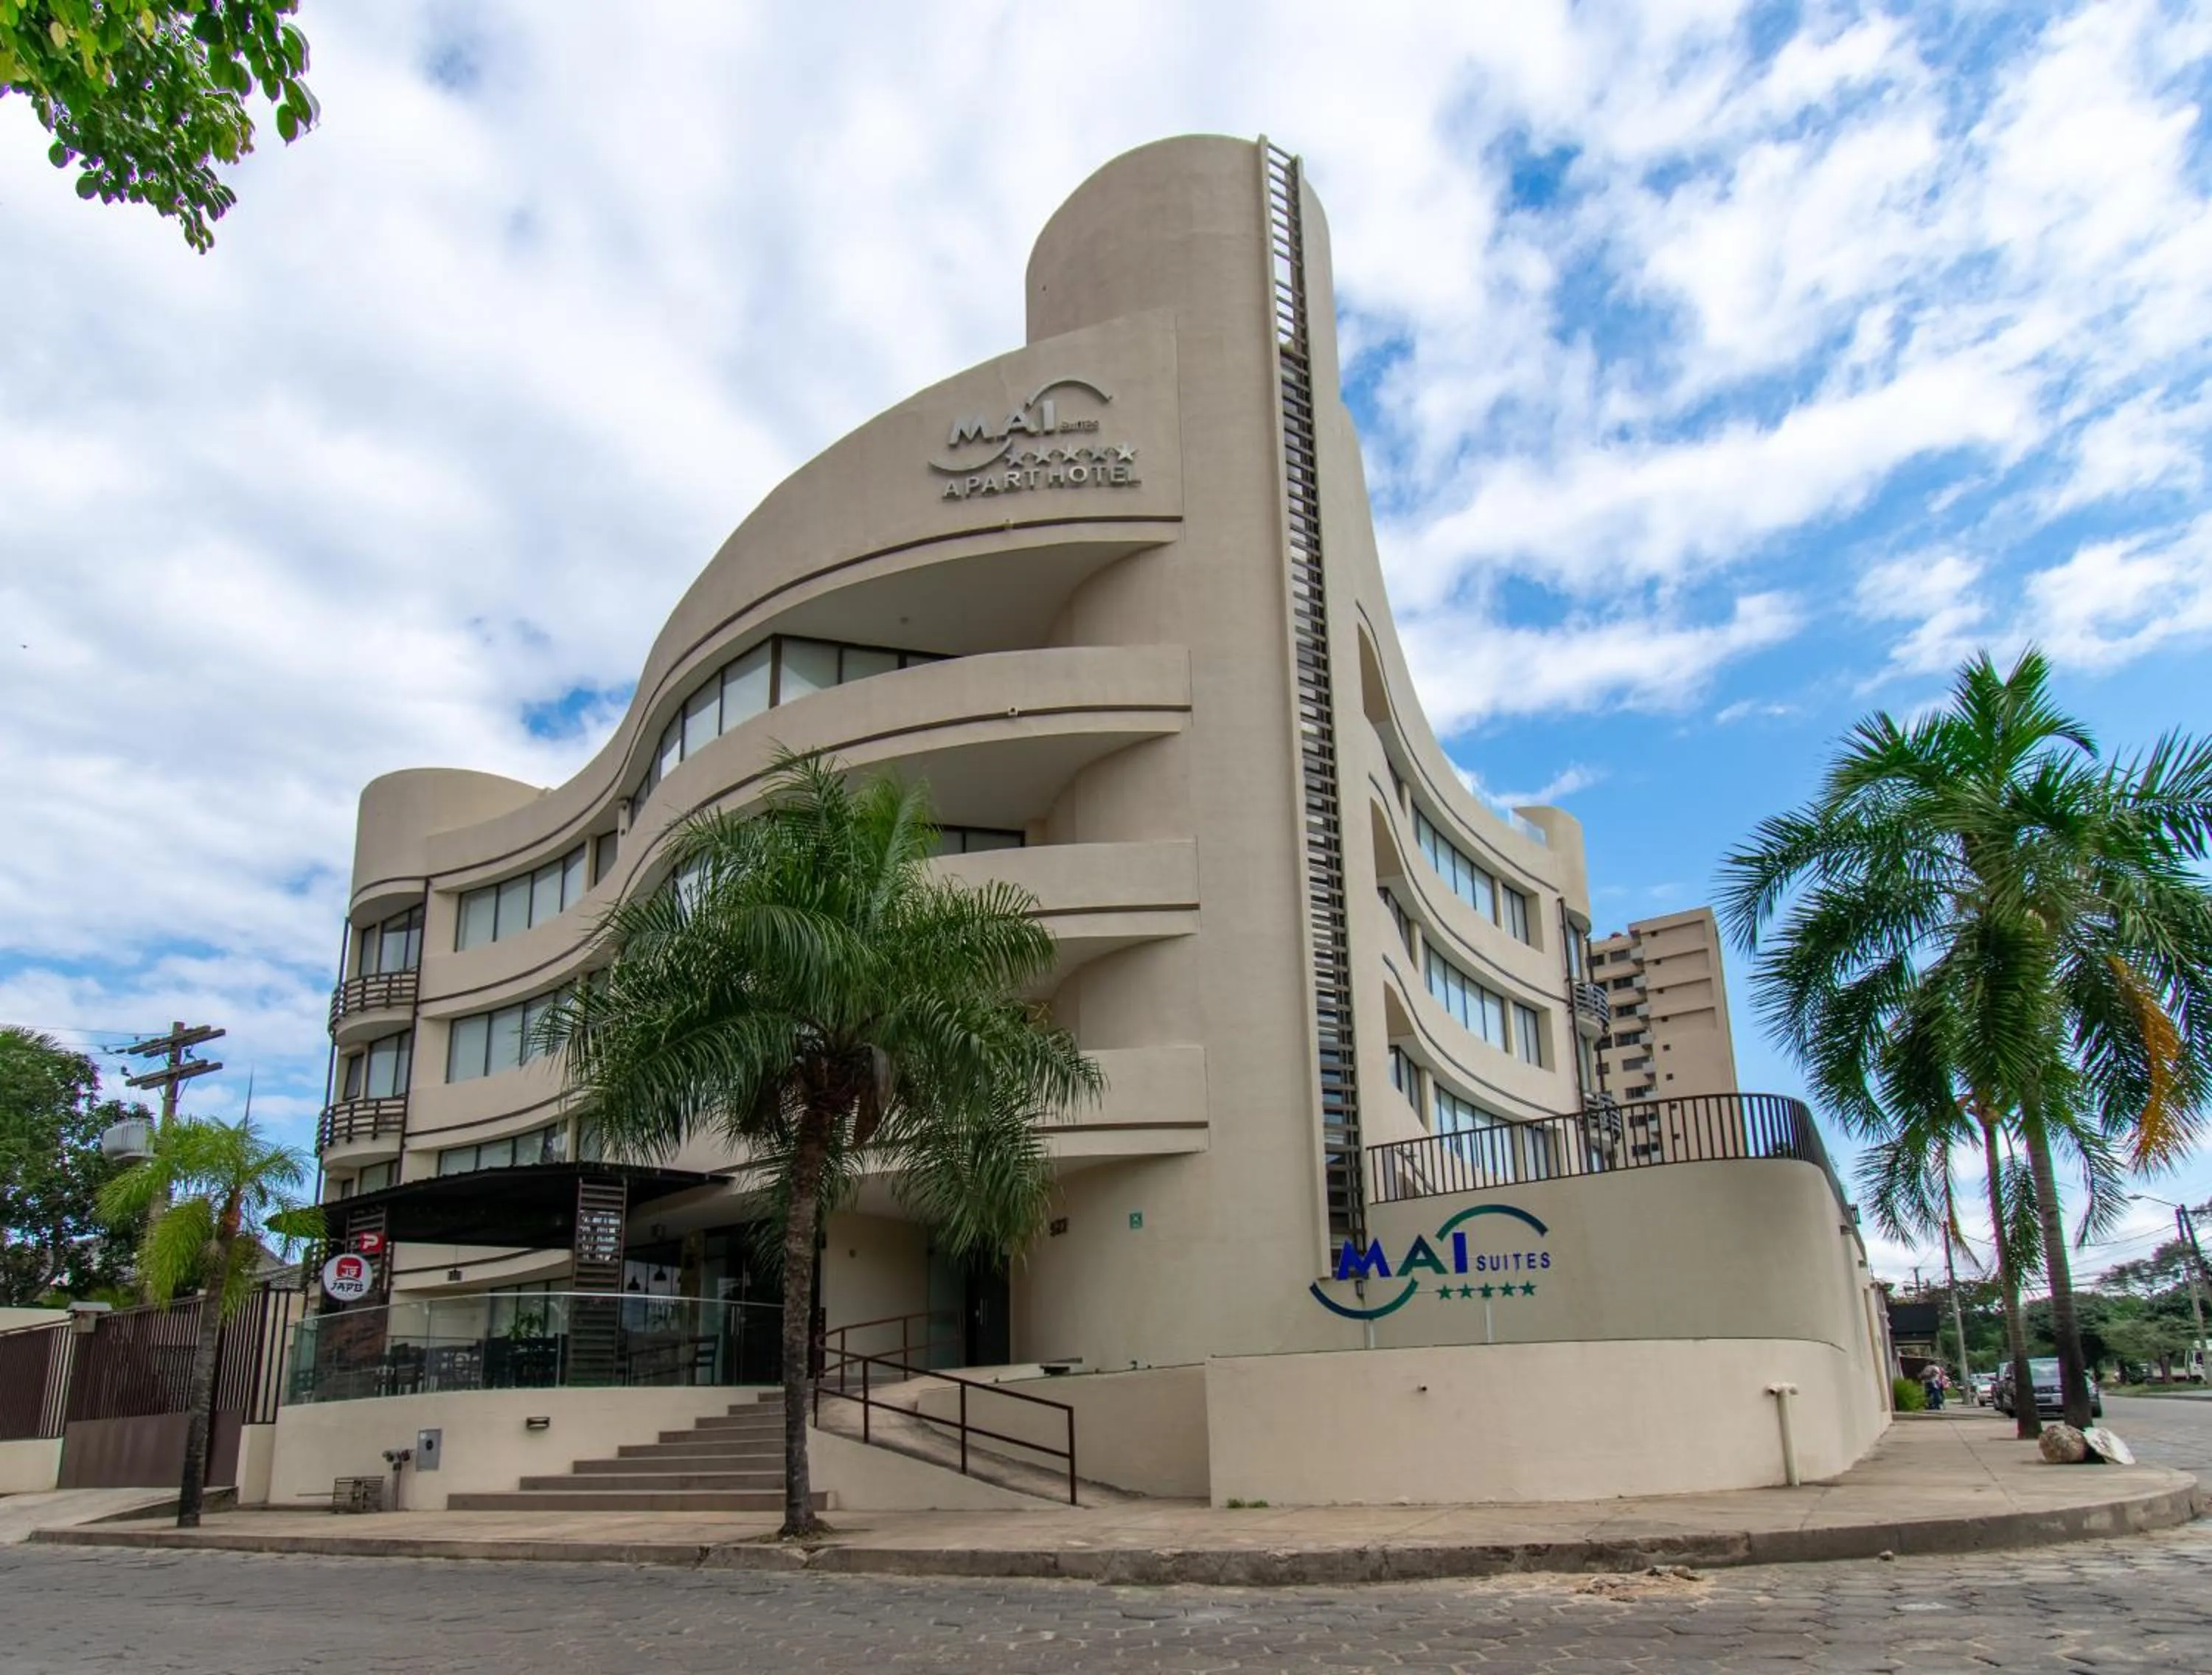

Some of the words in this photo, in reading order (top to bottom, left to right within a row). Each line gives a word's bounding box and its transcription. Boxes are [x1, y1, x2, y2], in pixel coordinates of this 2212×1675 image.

[948, 400, 1056, 447] MAI
[942, 468, 1040, 500] APART
[1335, 1232, 1469, 1281] MAI
[1475, 1252, 1552, 1272] SUITES
